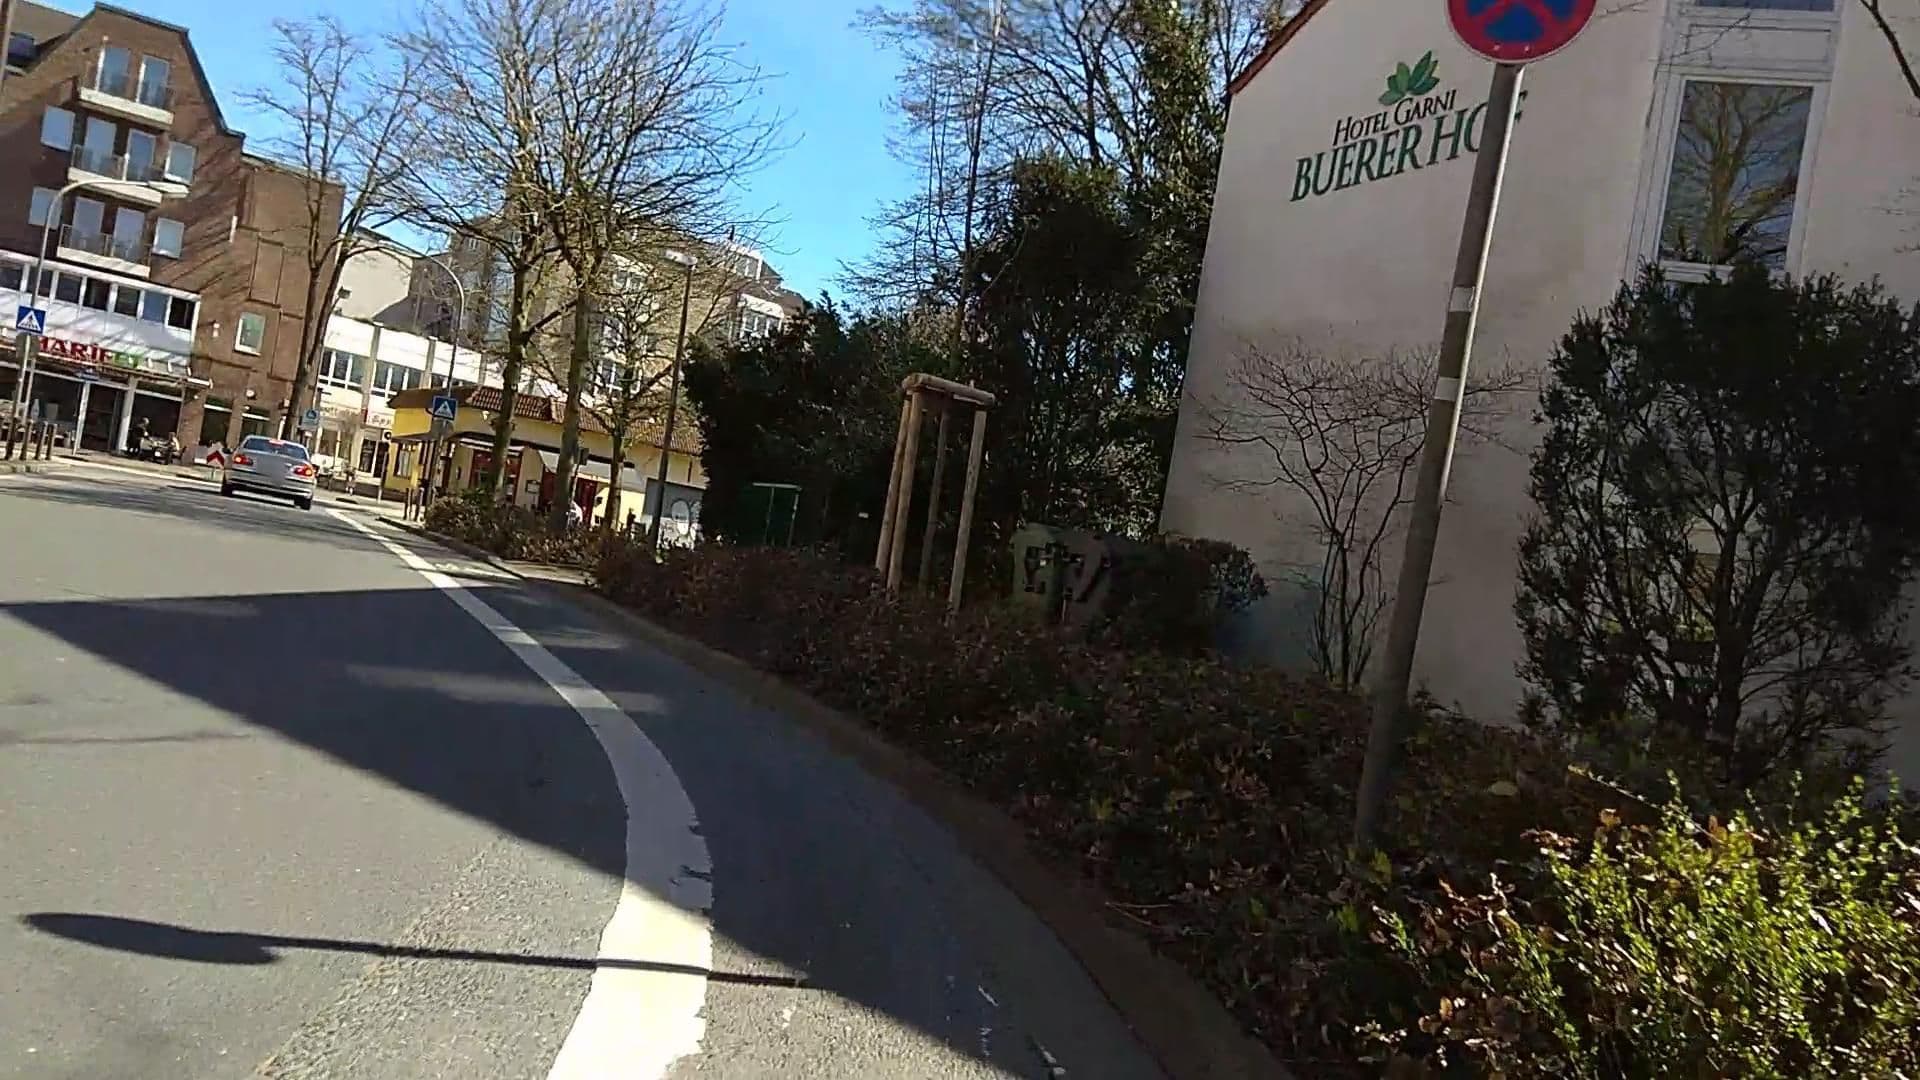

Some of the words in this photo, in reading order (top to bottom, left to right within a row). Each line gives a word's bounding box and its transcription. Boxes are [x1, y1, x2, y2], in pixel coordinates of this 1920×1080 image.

[1333, 113, 1389, 146] HOTEL
[1394, 89, 1456, 125] GARNI
[1290, 123, 1423, 202] BUERER
